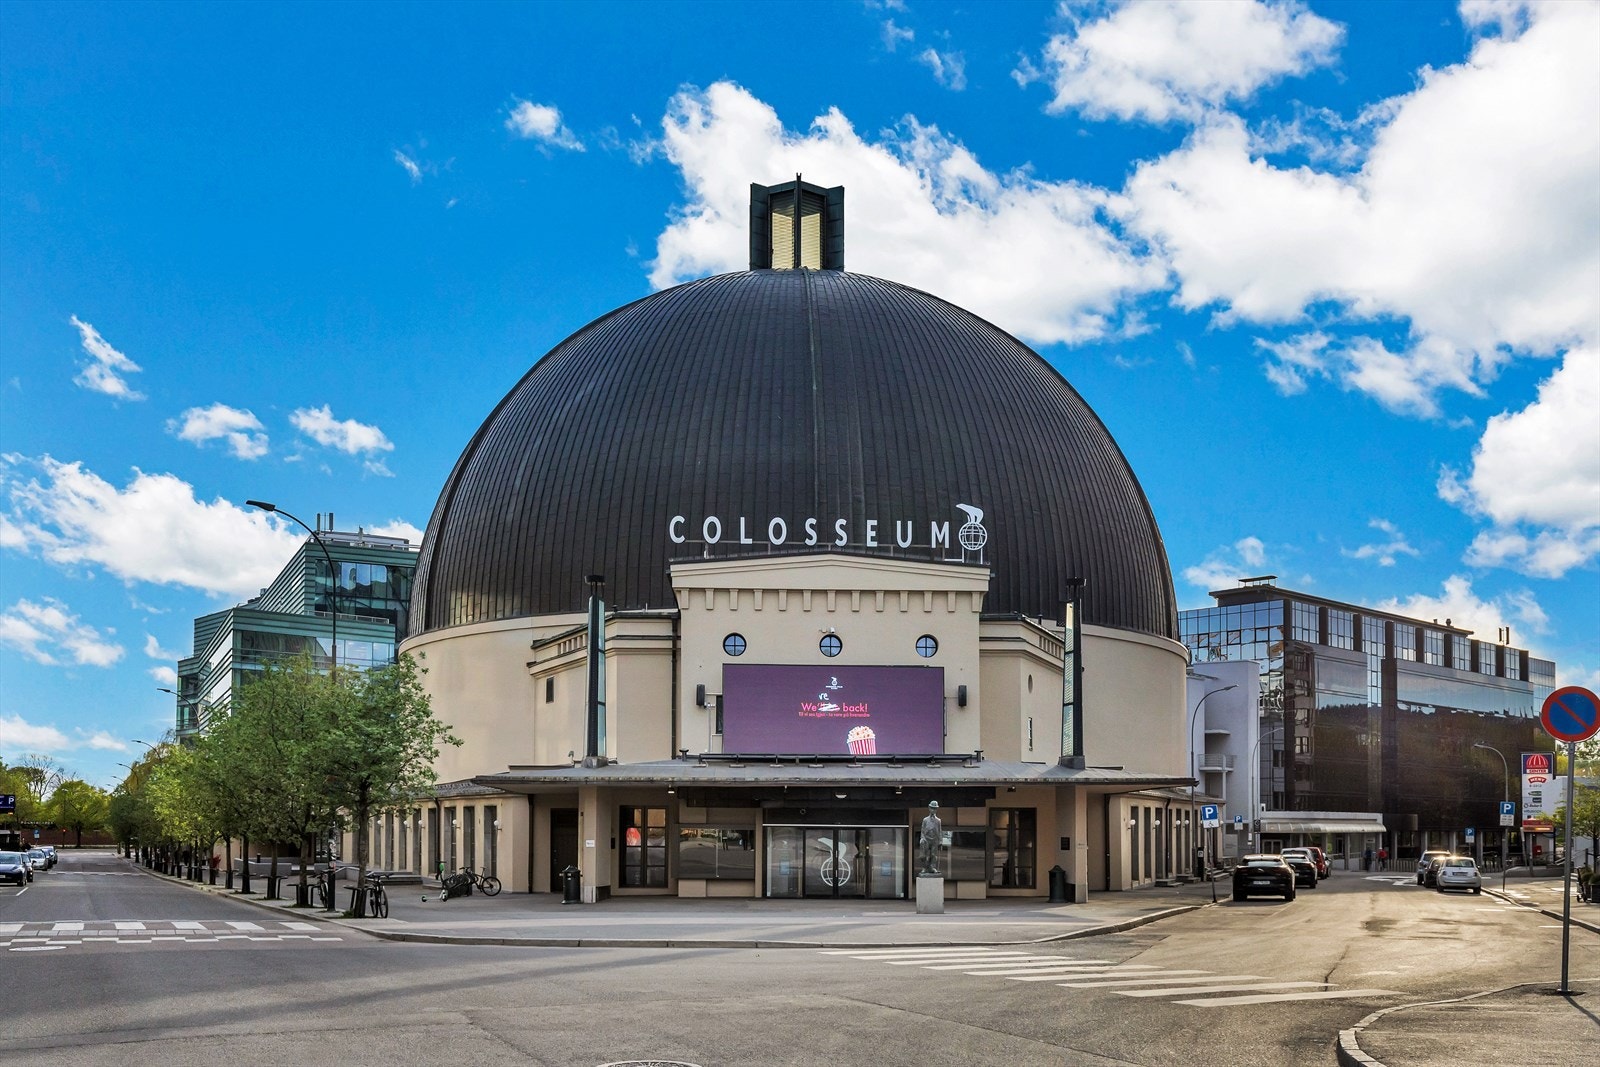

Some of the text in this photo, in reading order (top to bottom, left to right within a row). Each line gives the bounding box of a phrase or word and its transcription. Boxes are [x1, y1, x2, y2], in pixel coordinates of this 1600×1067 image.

[669, 515, 949, 548] COLOSSEUM
[843, 703, 868, 712] back!
[1205, 807, 1214, 819] P
[1503, 803, 1511, 813] P
